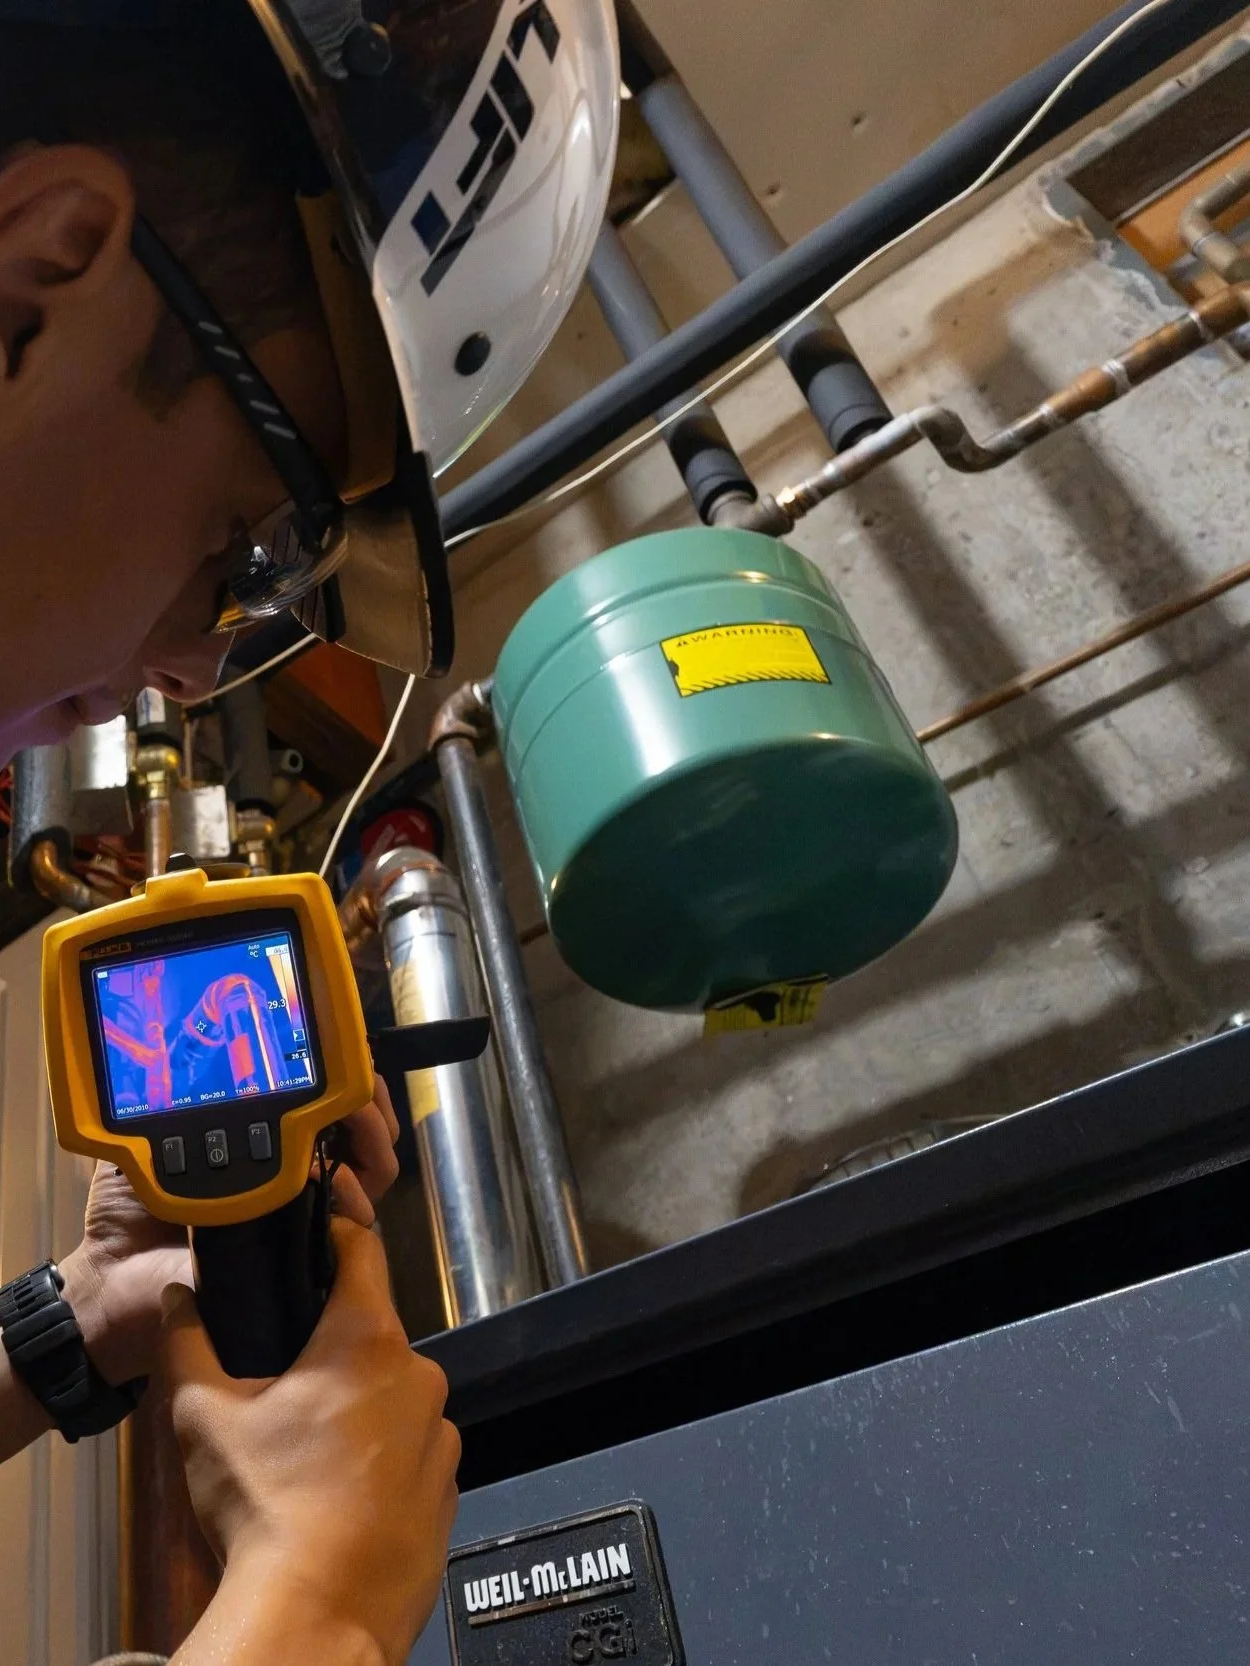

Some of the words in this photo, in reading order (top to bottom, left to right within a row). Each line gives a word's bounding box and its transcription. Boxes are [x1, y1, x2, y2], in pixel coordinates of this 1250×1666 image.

[267, 998, 286, 1010] 29.3
[291, 1051, 307, 1060] 26.6
[116, 1103, 150, 1115] 06/30/2010
[200, 1090, 226, 1101] BG=20.0
